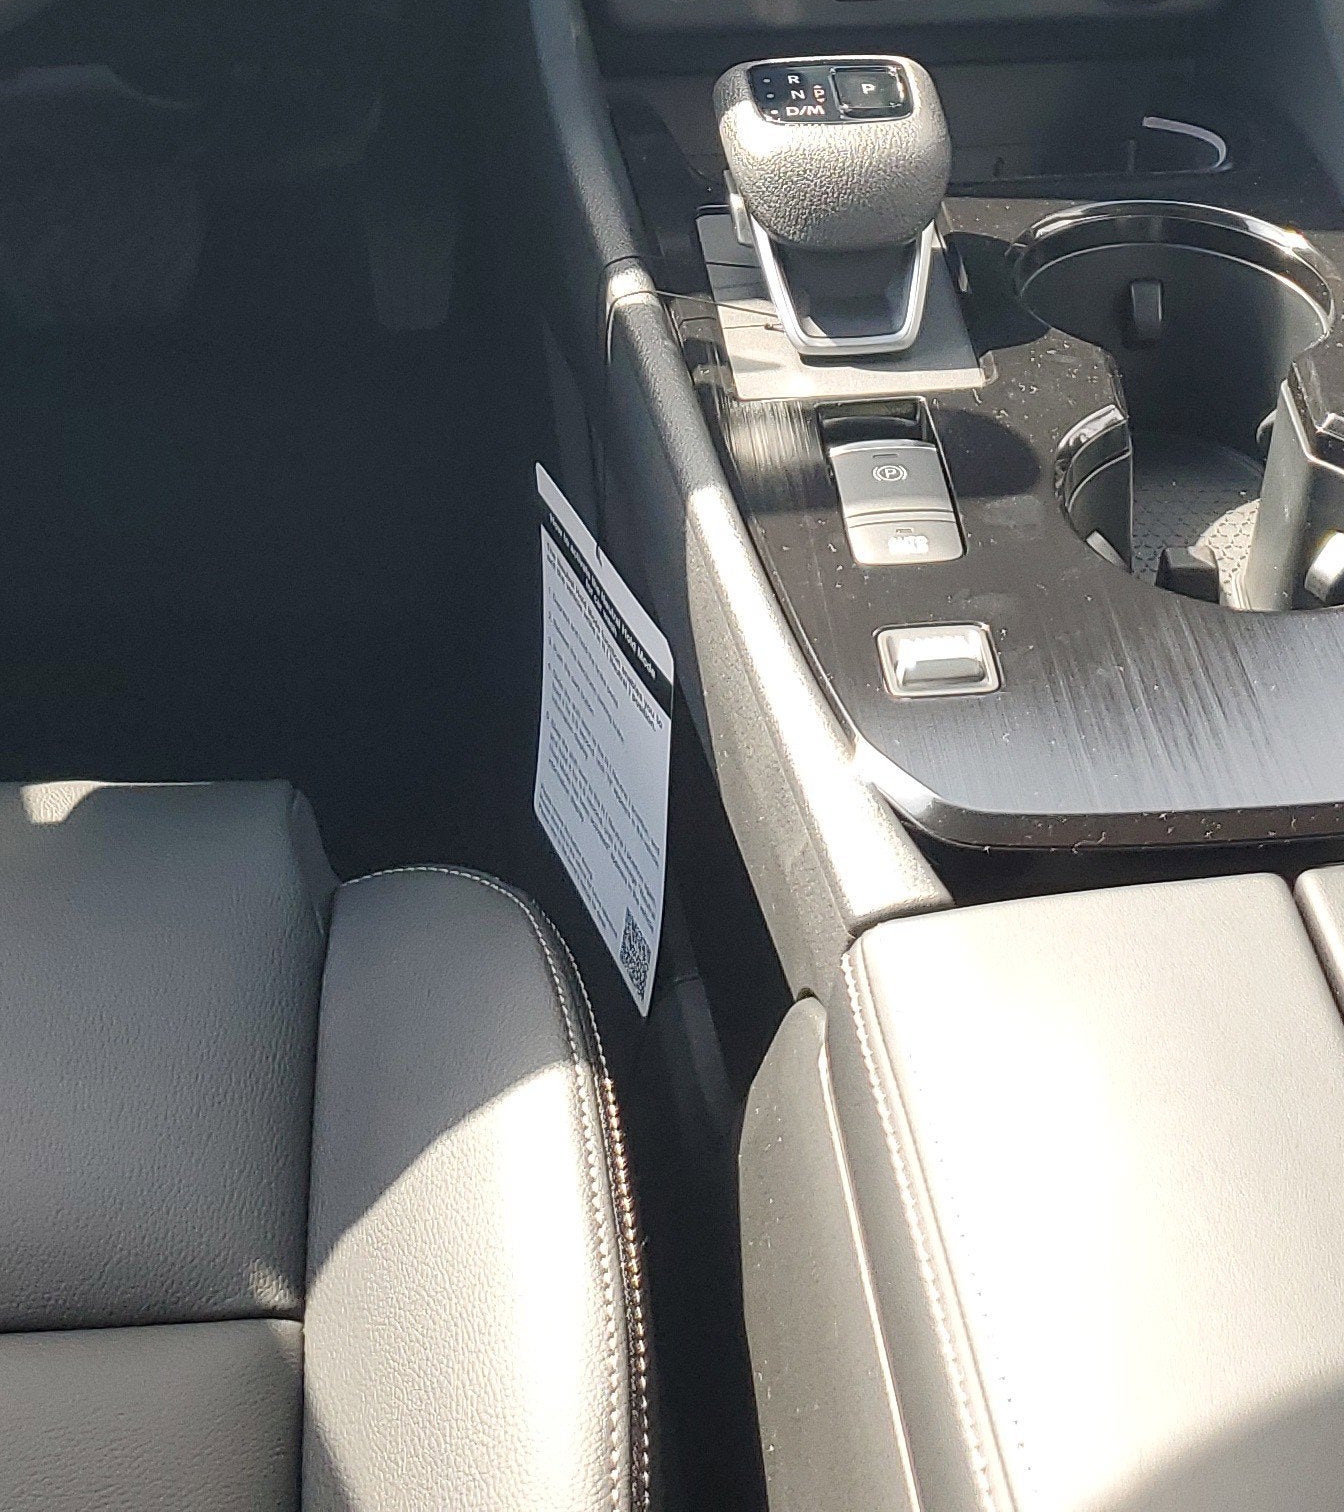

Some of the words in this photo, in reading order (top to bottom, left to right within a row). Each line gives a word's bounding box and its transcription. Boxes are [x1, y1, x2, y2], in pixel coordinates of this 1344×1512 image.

[787, 75, 801, 85] R
[790, 89, 806, 100] N
[861, 83, 877, 95] P
[785, 104, 826, 117] D/M
